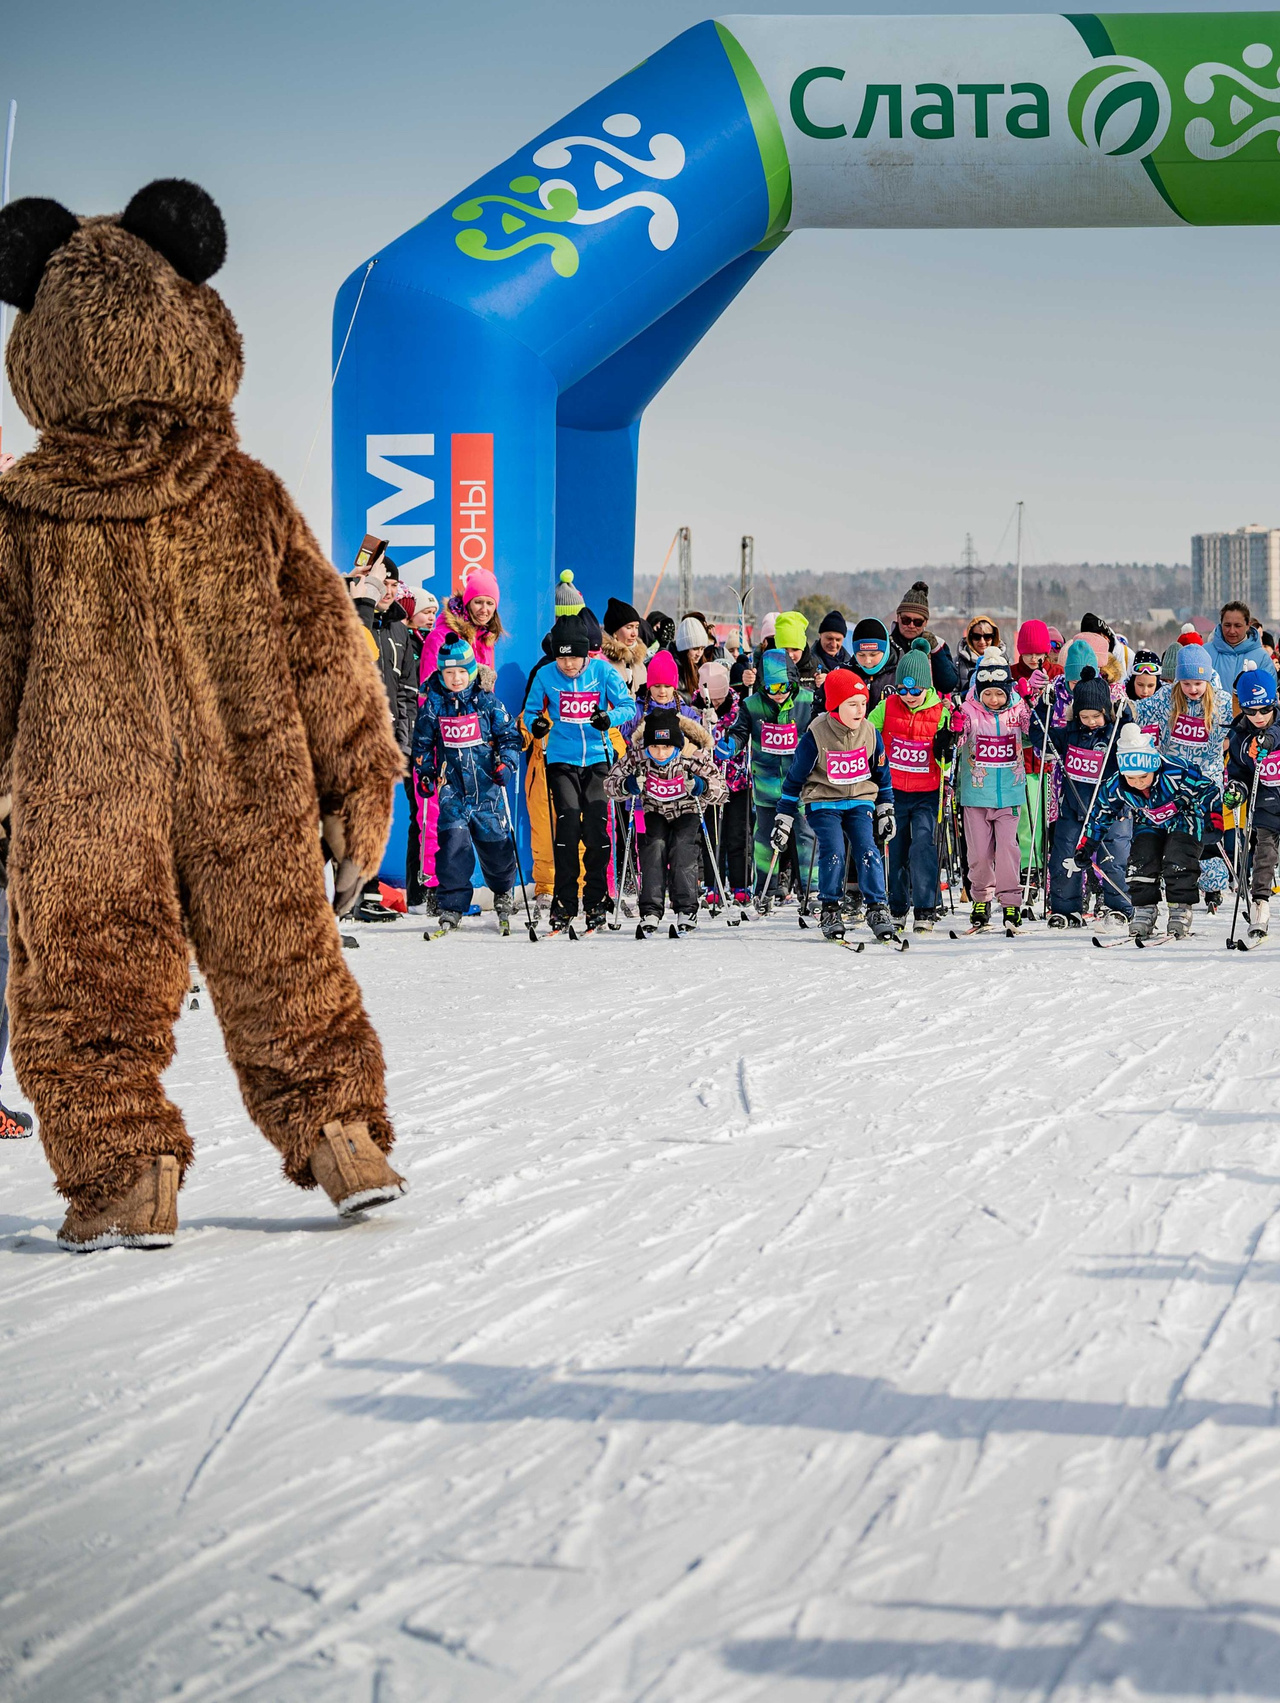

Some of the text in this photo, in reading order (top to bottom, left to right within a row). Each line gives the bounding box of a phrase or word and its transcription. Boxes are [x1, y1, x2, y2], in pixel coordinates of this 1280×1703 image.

[789, 66, 1050, 140] Слата
[561, 700, 597, 713] 2066
[443, 722, 477, 738] 2027
[1174, 722, 1205, 738] 2015
[765, 732, 795, 745] 2013
[891, 746, 928, 763] 2039
[978, 744, 1014, 758] 2055
[829, 757, 866, 774] 2058
[1066, 755, 1098, 774] 2035
[1118, 753, 1152, 769] ОССИИ
[650, 782, 682, 795] 2031
